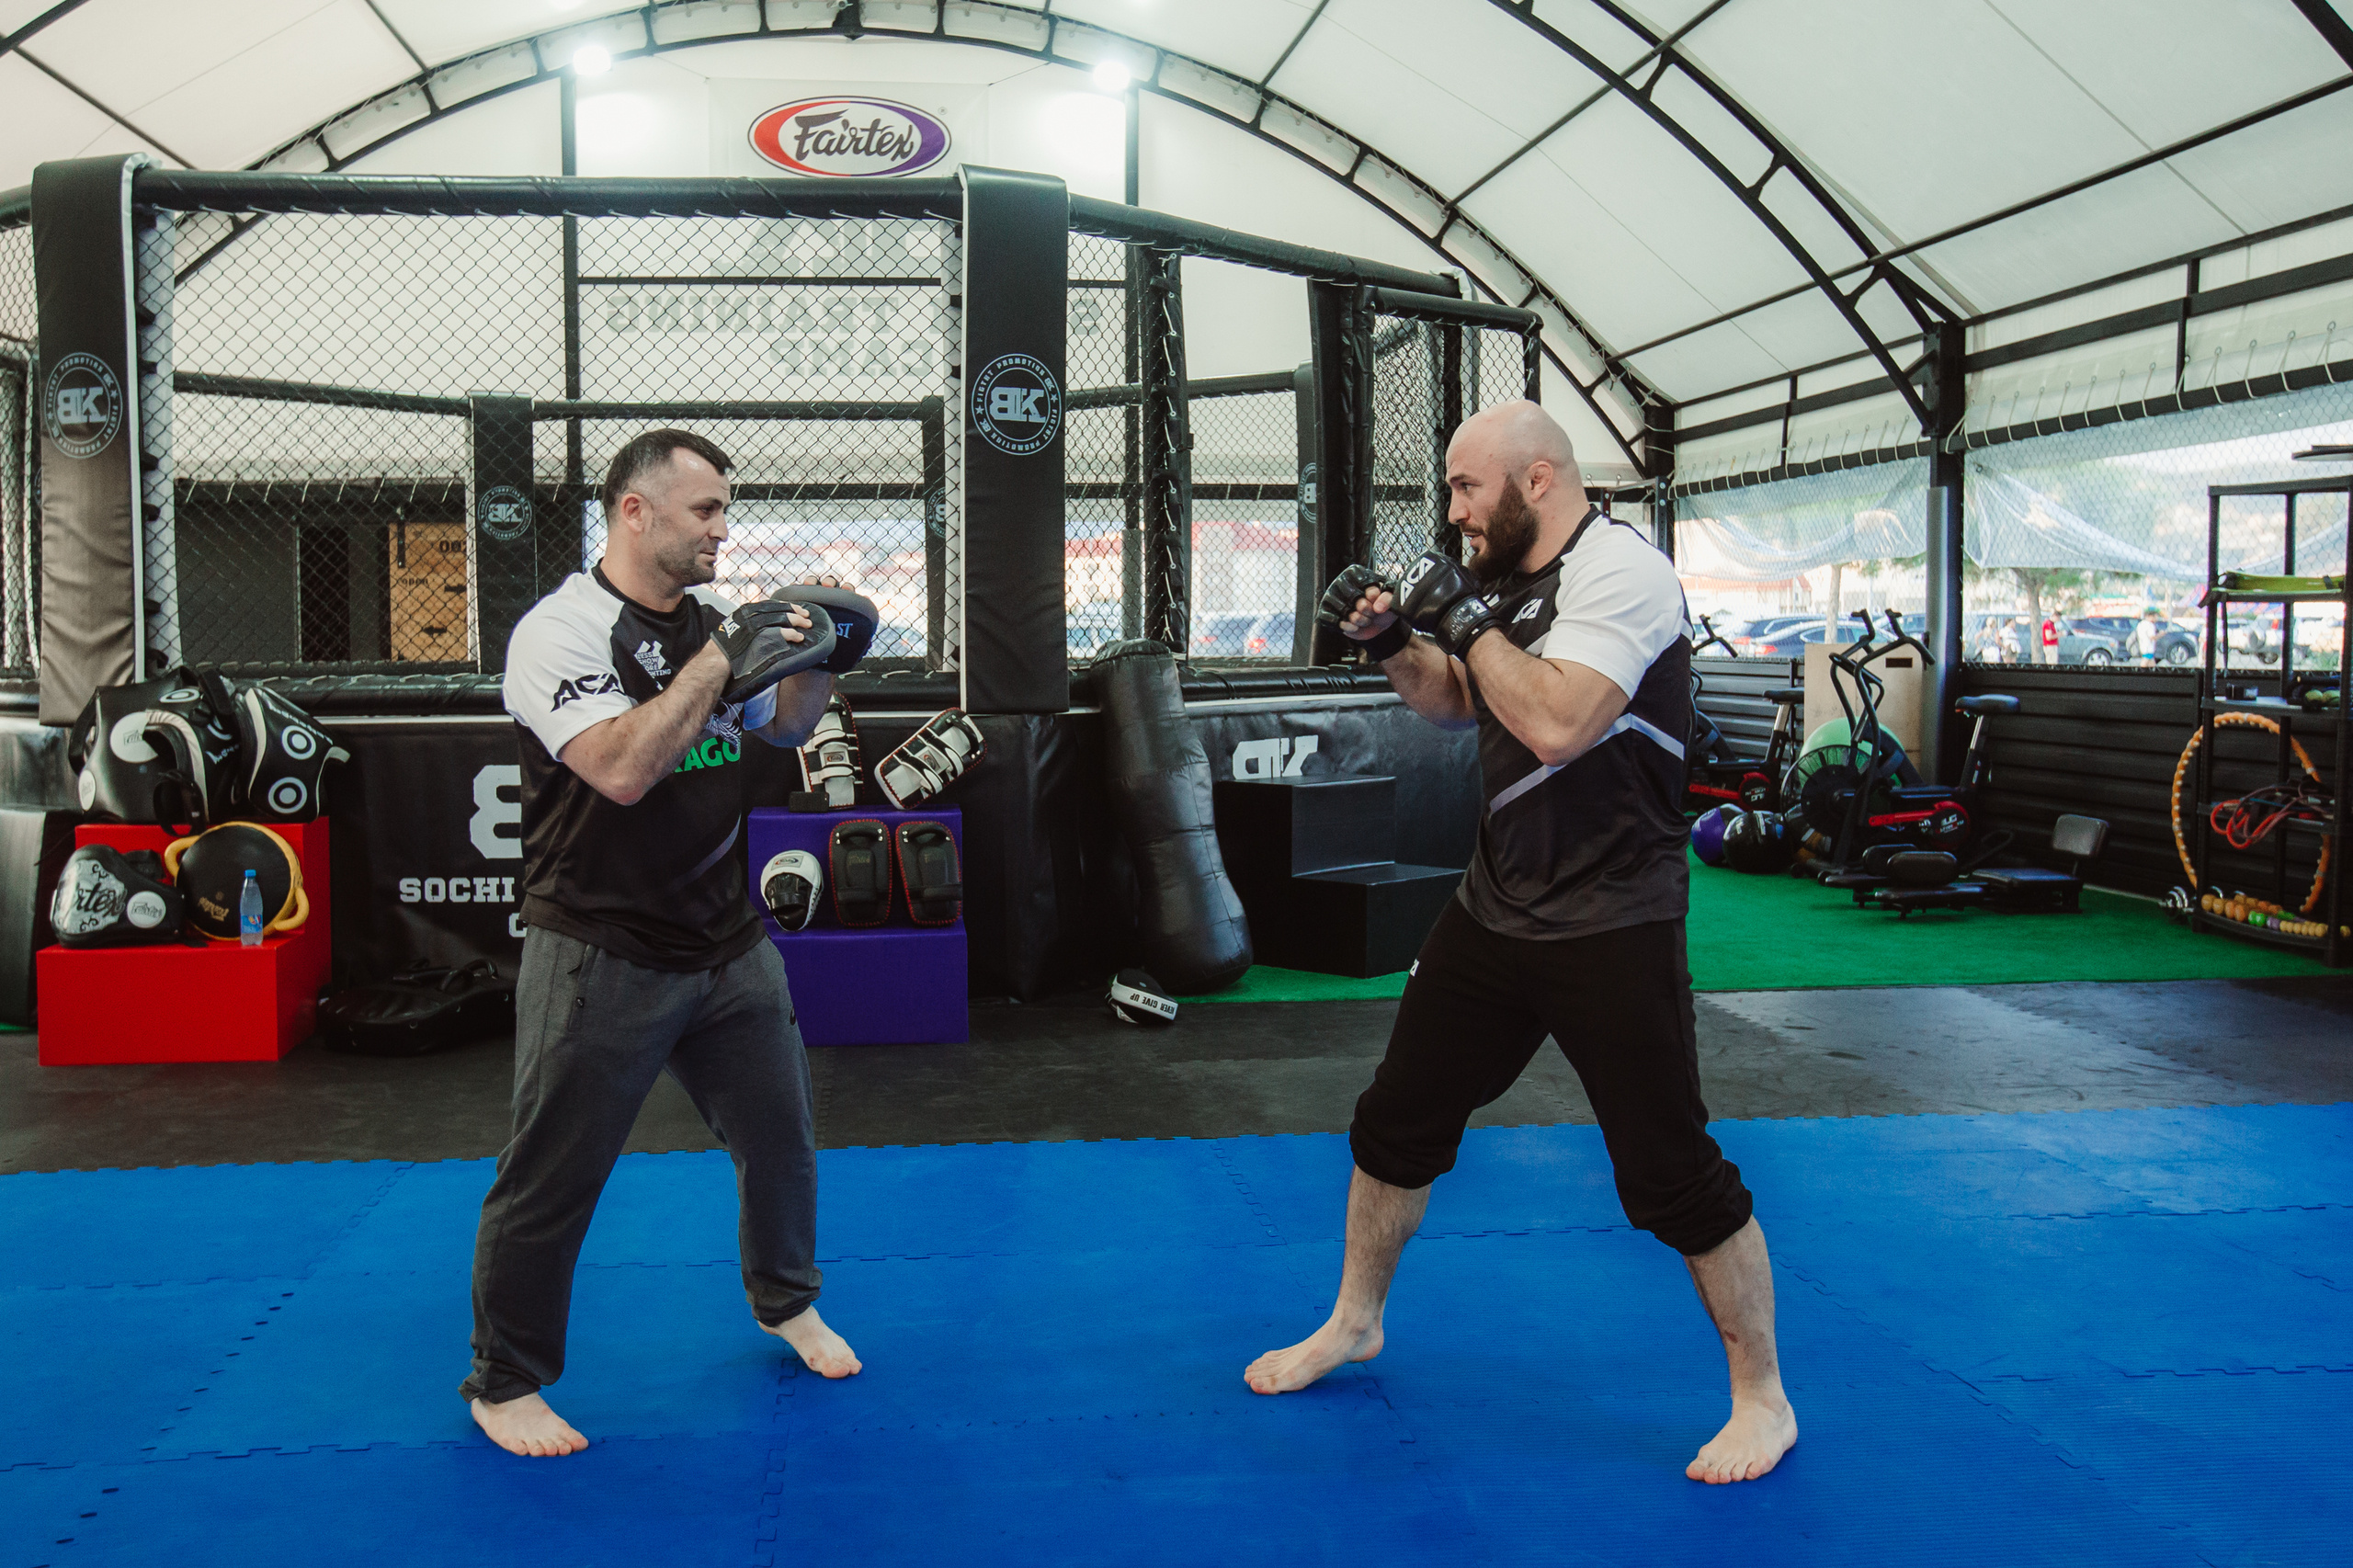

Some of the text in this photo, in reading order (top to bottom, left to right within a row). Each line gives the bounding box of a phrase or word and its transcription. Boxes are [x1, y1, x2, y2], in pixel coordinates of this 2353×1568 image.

[794, 108, 914, 162] Fairtex
[57, 386, 108, 425] BK
[989, 386, 1047, 423] BK
[1400, 556, 1436, 607] ACA
[551, 673, 626, 713] ACA
[399, 877, 516, 903] SOCHI
[1130, 994, 1140, 1002] UP
[1142, 996, 1158, 1008] GIVE
